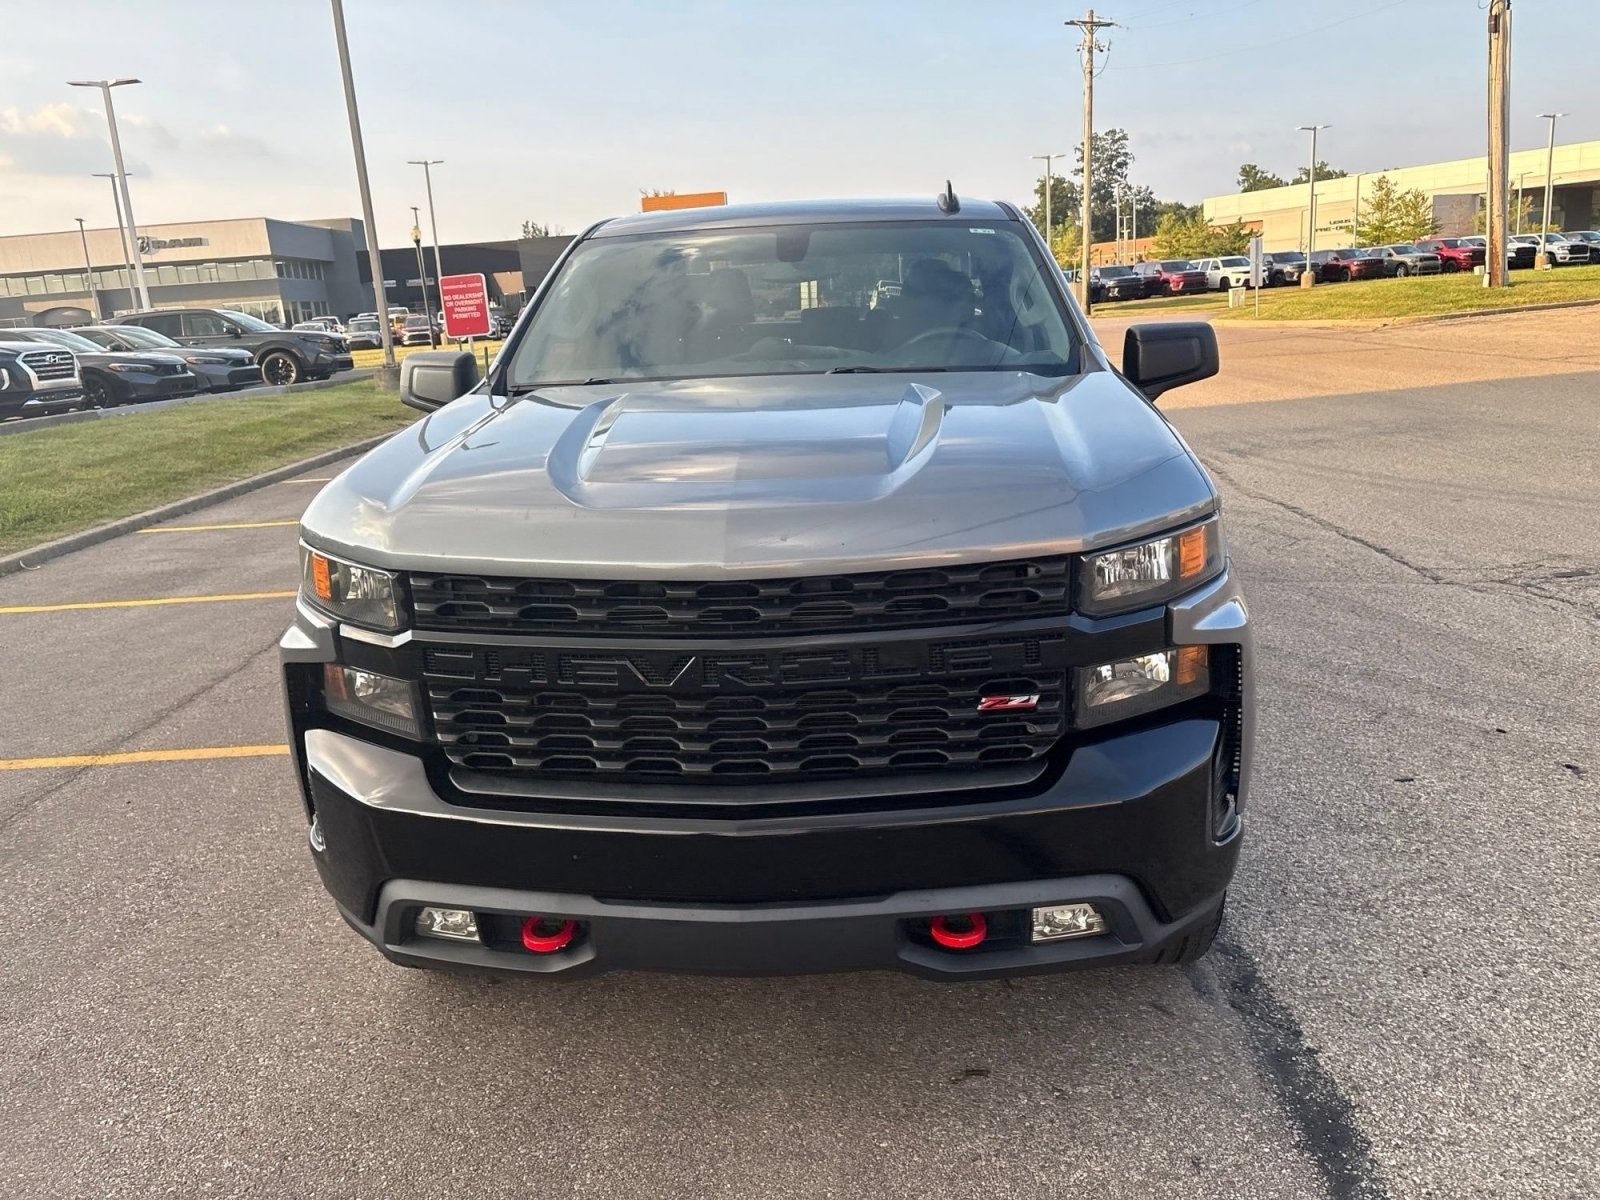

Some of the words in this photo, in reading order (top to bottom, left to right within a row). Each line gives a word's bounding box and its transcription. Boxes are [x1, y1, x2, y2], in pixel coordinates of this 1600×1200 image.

[452, 292, 483, 300] DEALERSHIP
[454, 299, 483, 307] OVERNIGHT
[454, 305, 477, 313] PARKING
[422, 632, 1066, 688] CHEVROLET
